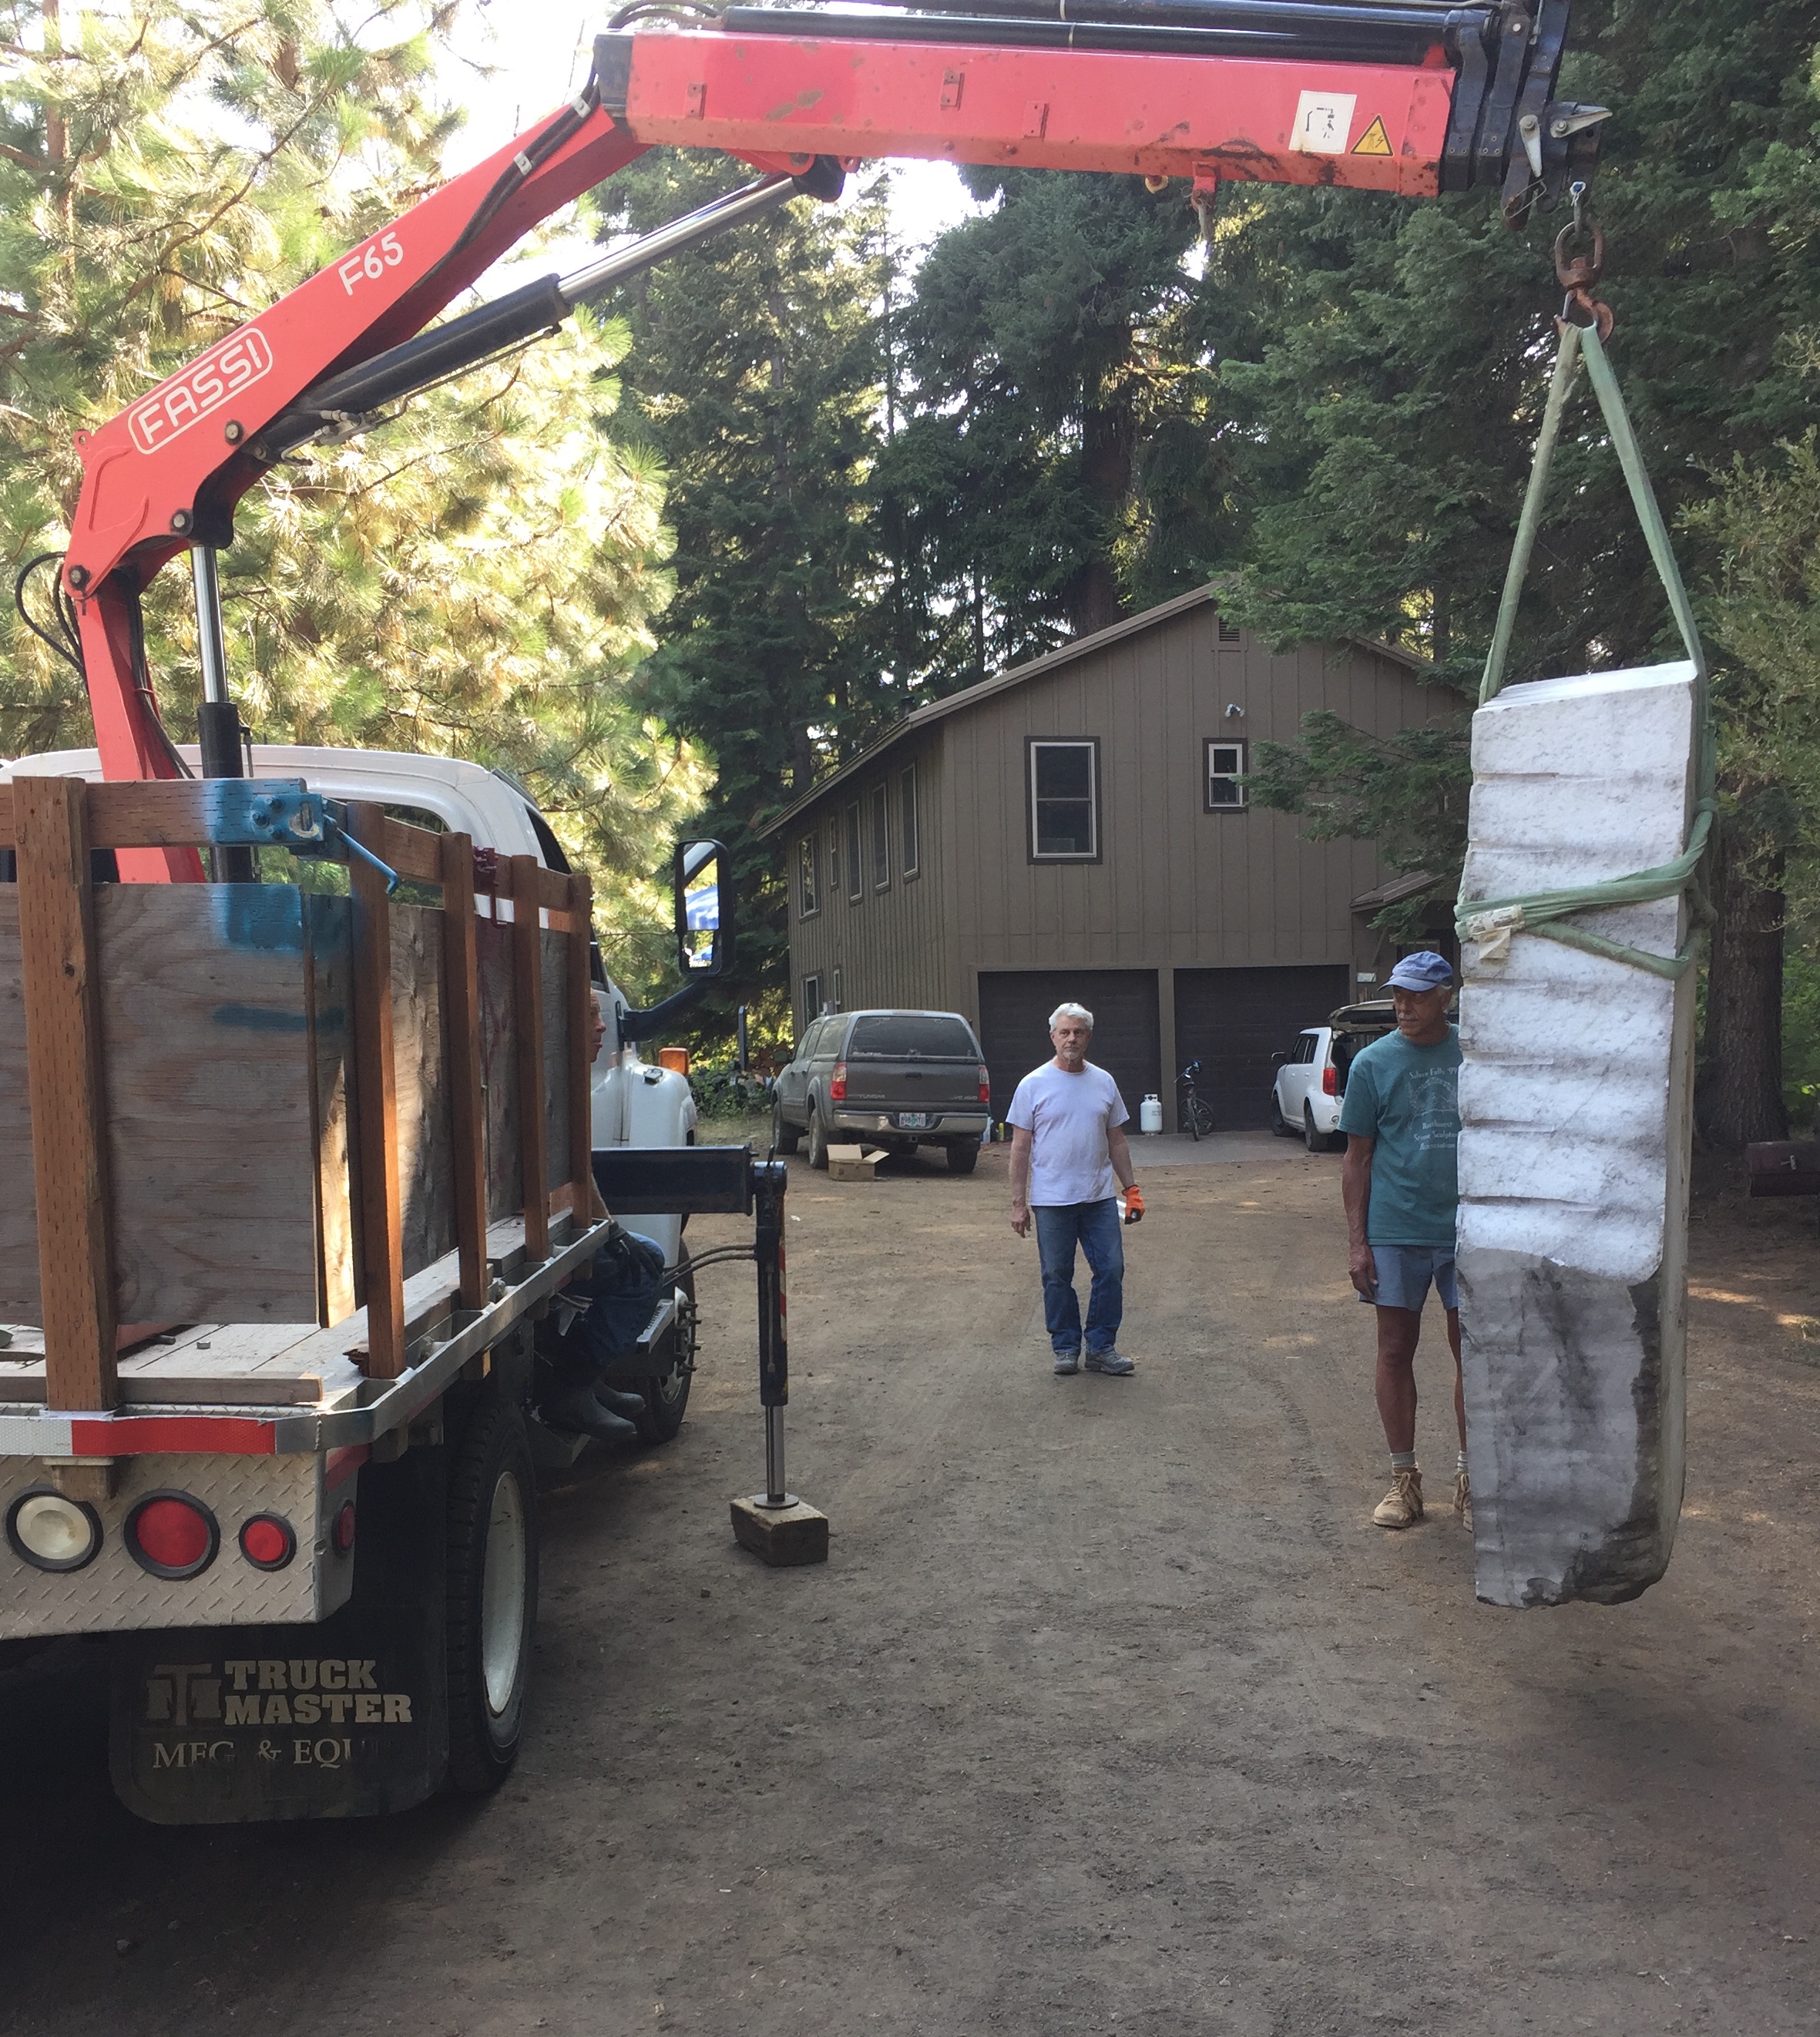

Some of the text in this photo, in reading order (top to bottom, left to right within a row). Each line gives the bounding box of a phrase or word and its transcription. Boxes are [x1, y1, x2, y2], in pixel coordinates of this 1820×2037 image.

[337, 231, 404, 296] F65
[137, 338, 262, 445] FASSI
[224, 1659, 378, 1690] TRUCK
[224, 1694, 412, 1726] MASTER
